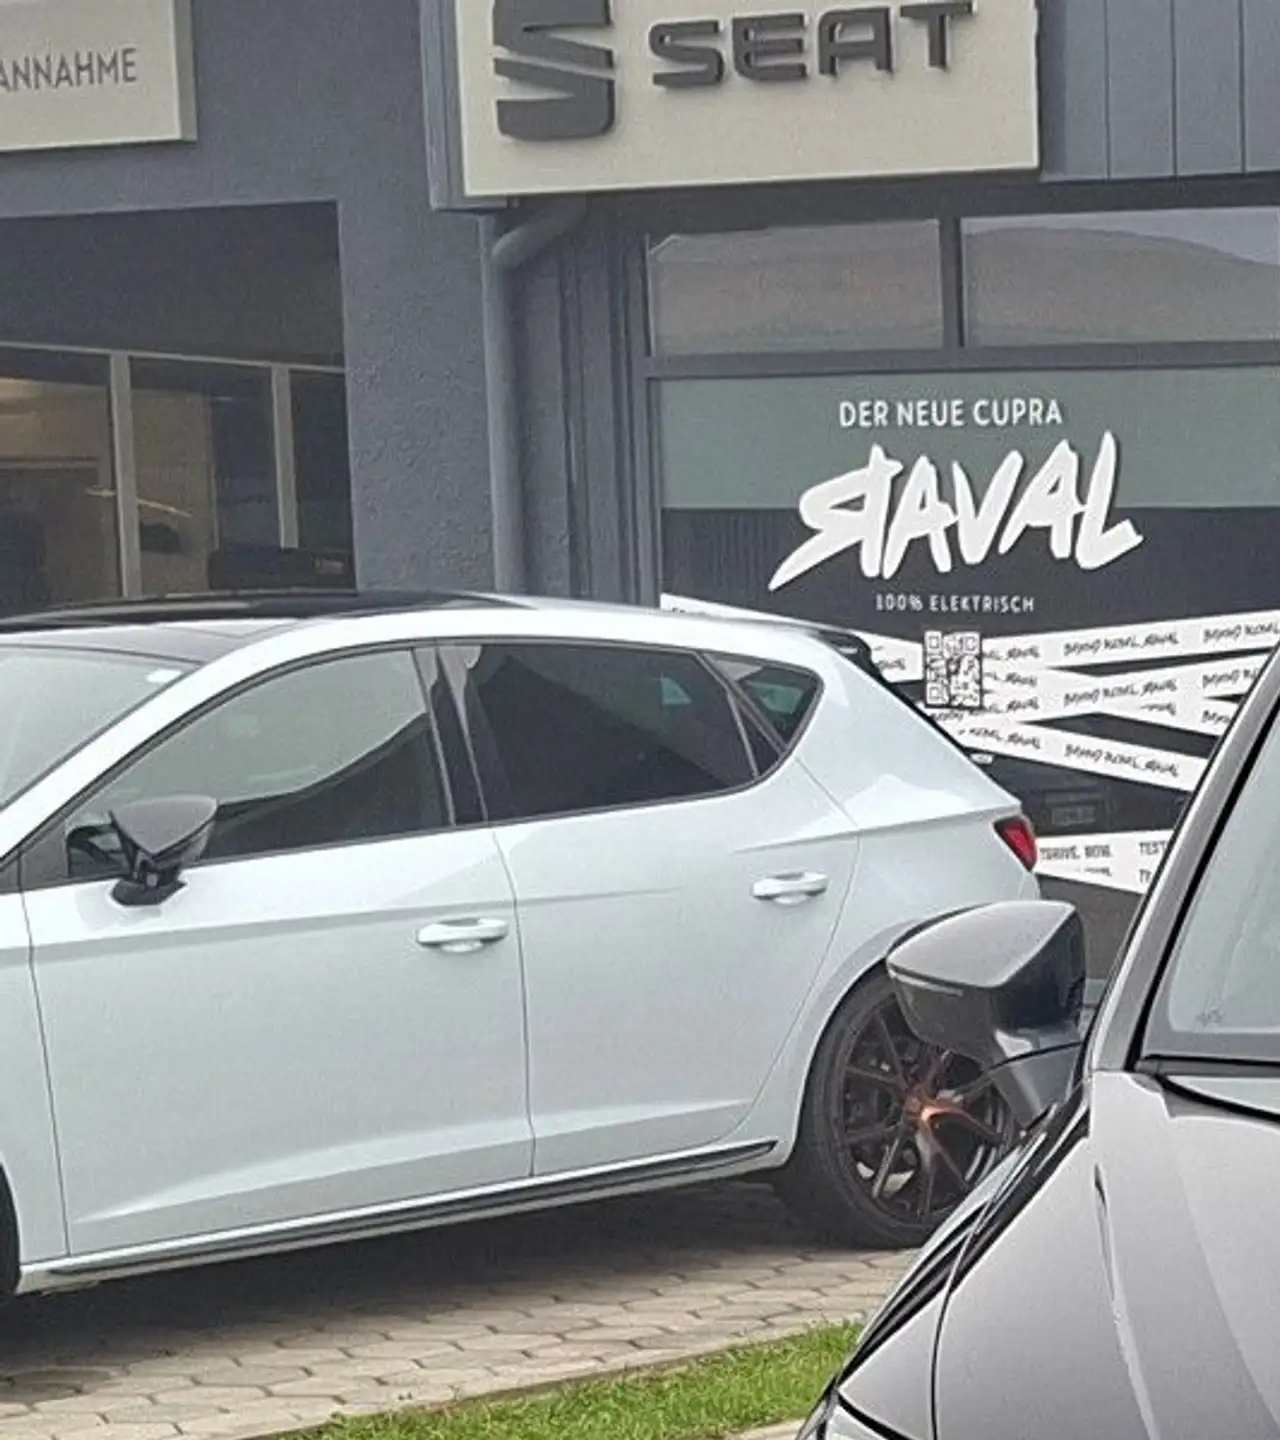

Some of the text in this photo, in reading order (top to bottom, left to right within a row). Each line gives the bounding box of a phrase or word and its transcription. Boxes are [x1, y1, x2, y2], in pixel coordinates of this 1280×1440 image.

[649, 3, 973, 86] SEAT
[839, 398, 1062, 427] DER NEUE CUPRA
[875, 594, 1034, 613] 100% ELEKTRISCH
